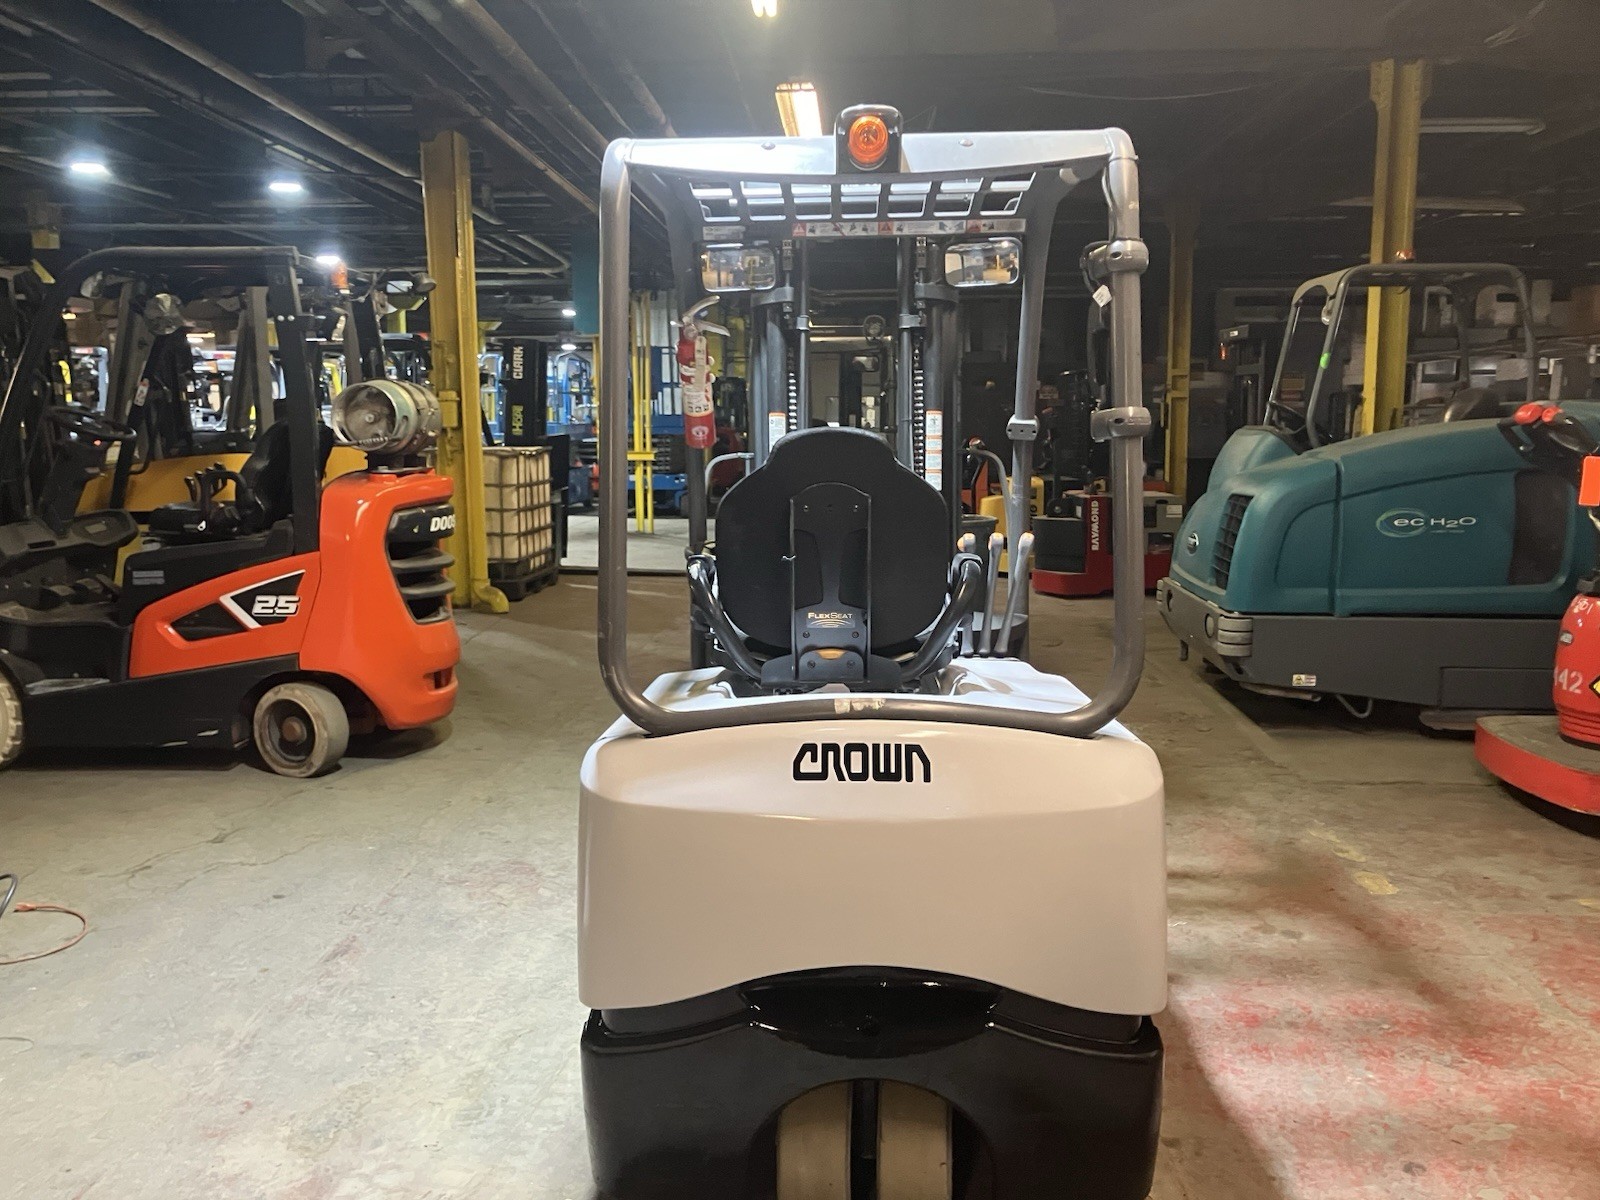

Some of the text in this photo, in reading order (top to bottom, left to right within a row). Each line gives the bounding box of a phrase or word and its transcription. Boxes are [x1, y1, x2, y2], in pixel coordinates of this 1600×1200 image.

[512, 346, 524, 379] CLARK
[1091, 500, 1099, 551] RAYMOND
[252, 595, 300, 616] 25
[793, 743, 931, 783] CROWN
